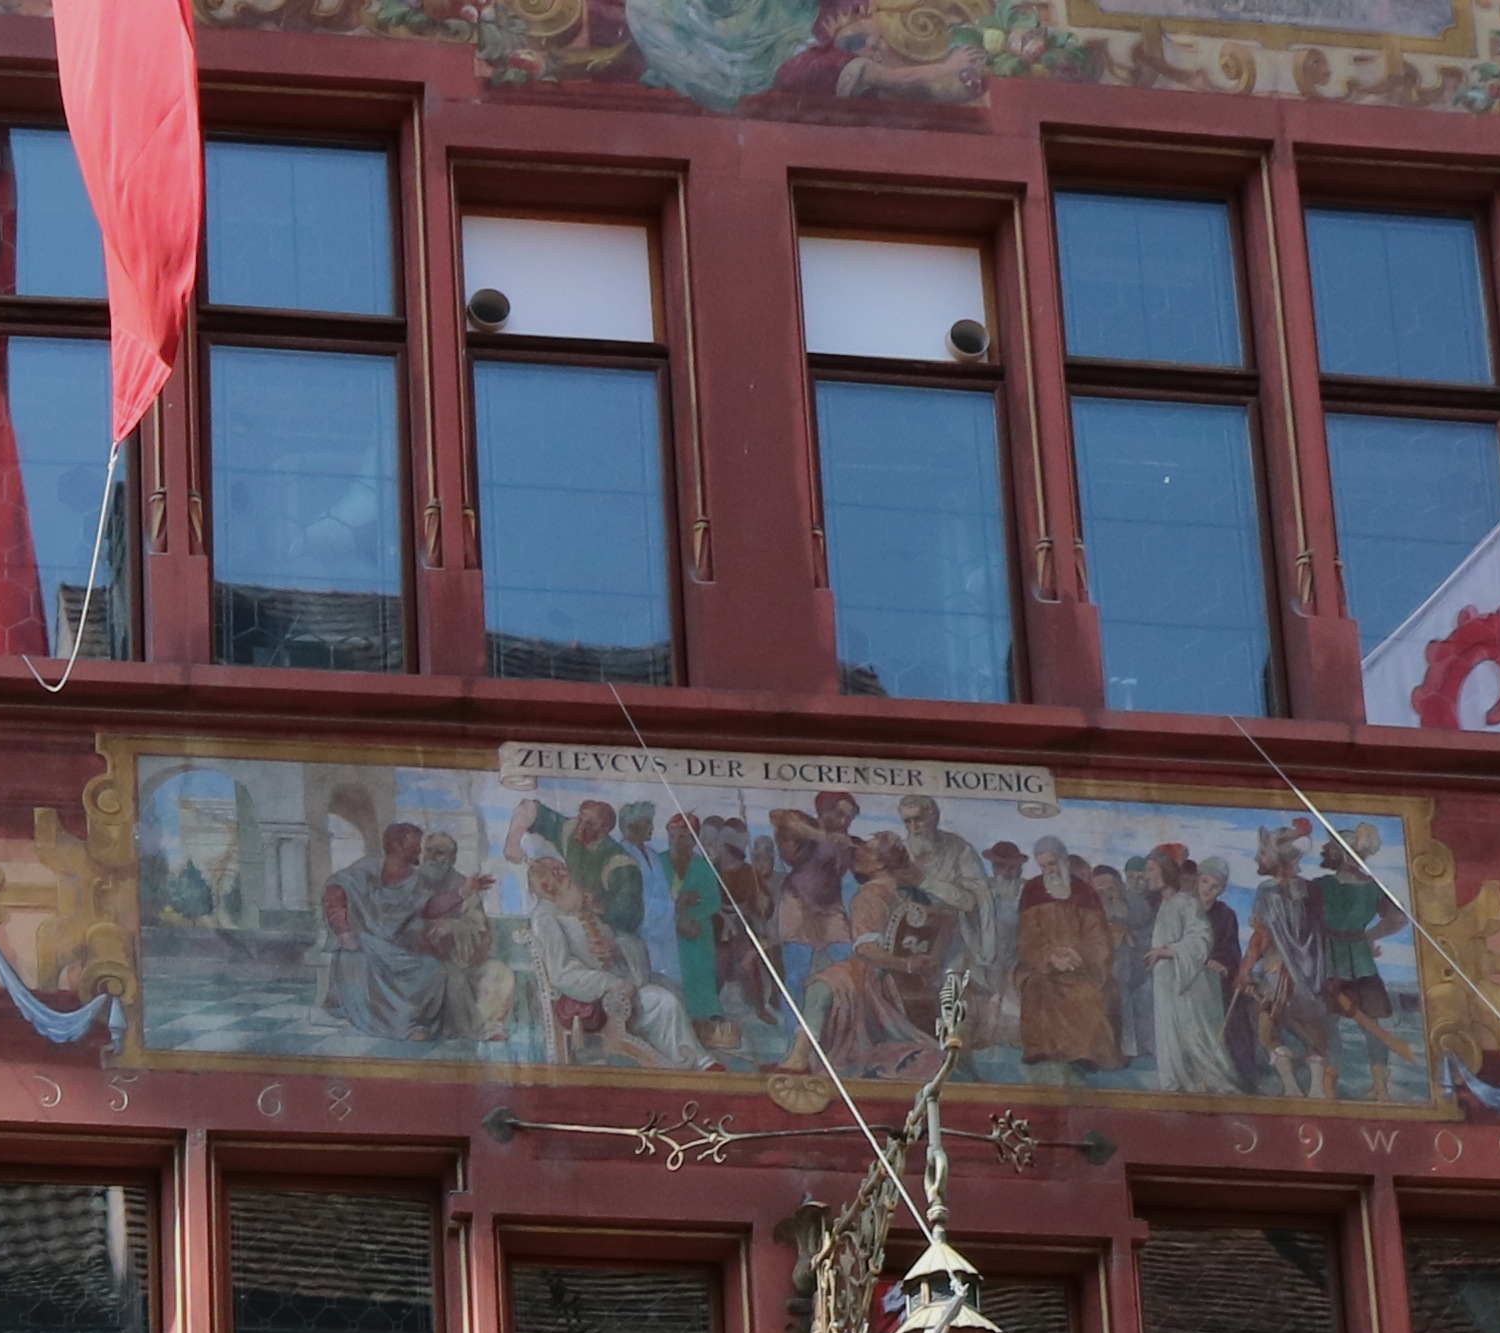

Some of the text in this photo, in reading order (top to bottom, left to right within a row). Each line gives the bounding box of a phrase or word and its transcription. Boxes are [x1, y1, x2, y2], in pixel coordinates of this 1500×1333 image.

[517, 747, 1045, 795] ZELEVCVS DER LOCRENSER KOENIG
